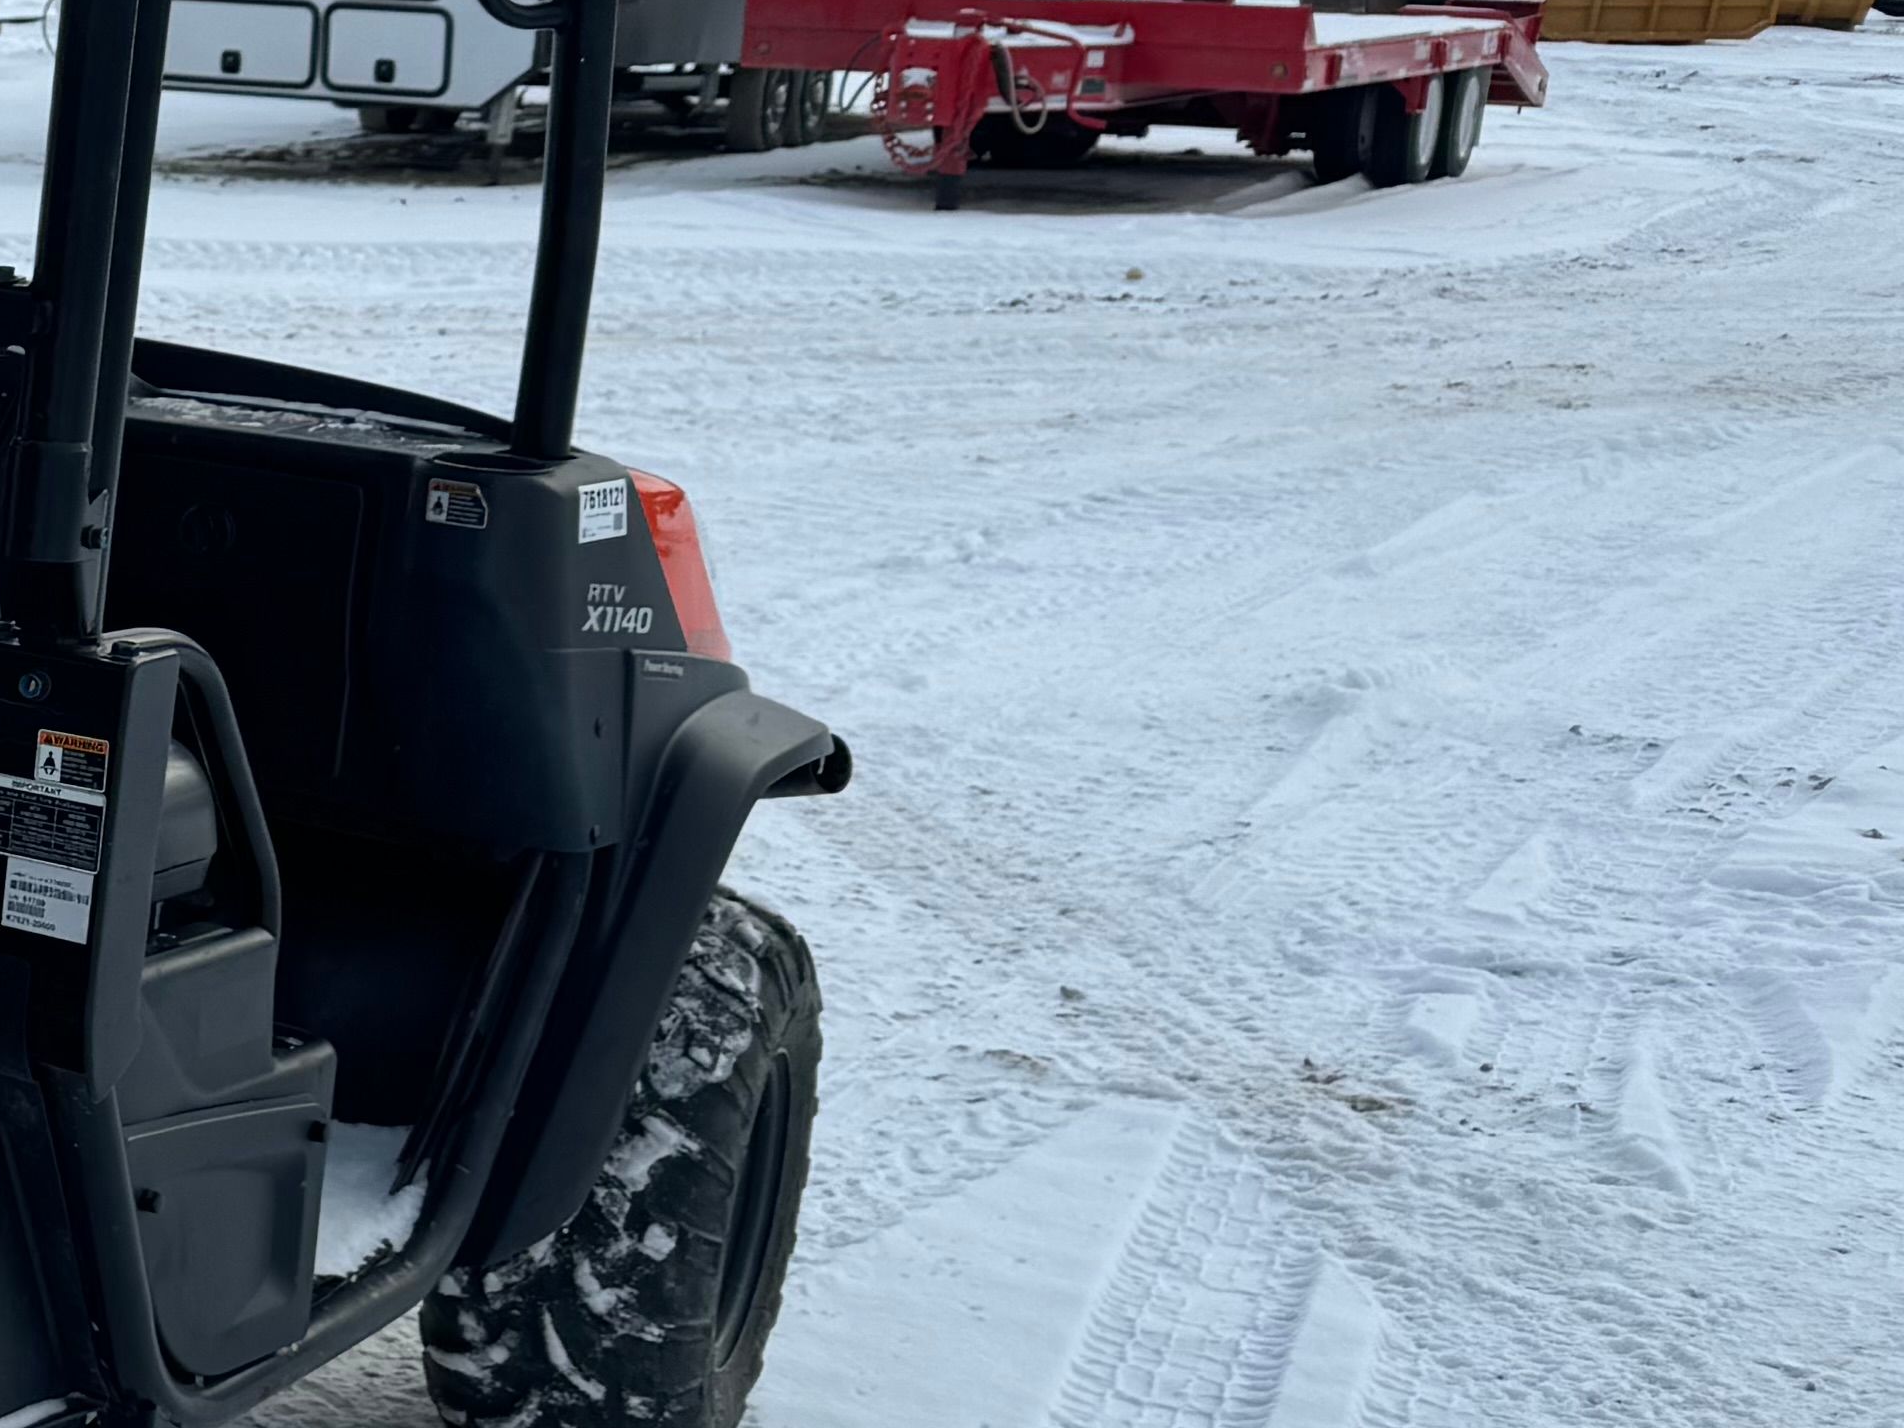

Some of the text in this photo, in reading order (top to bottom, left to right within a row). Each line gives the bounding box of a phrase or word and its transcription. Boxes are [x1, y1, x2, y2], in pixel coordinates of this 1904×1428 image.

[587, 583, 626, 603] RTV
[581, 605, 653, 634] X1140
[54, 735, 104, 753] WARNING
